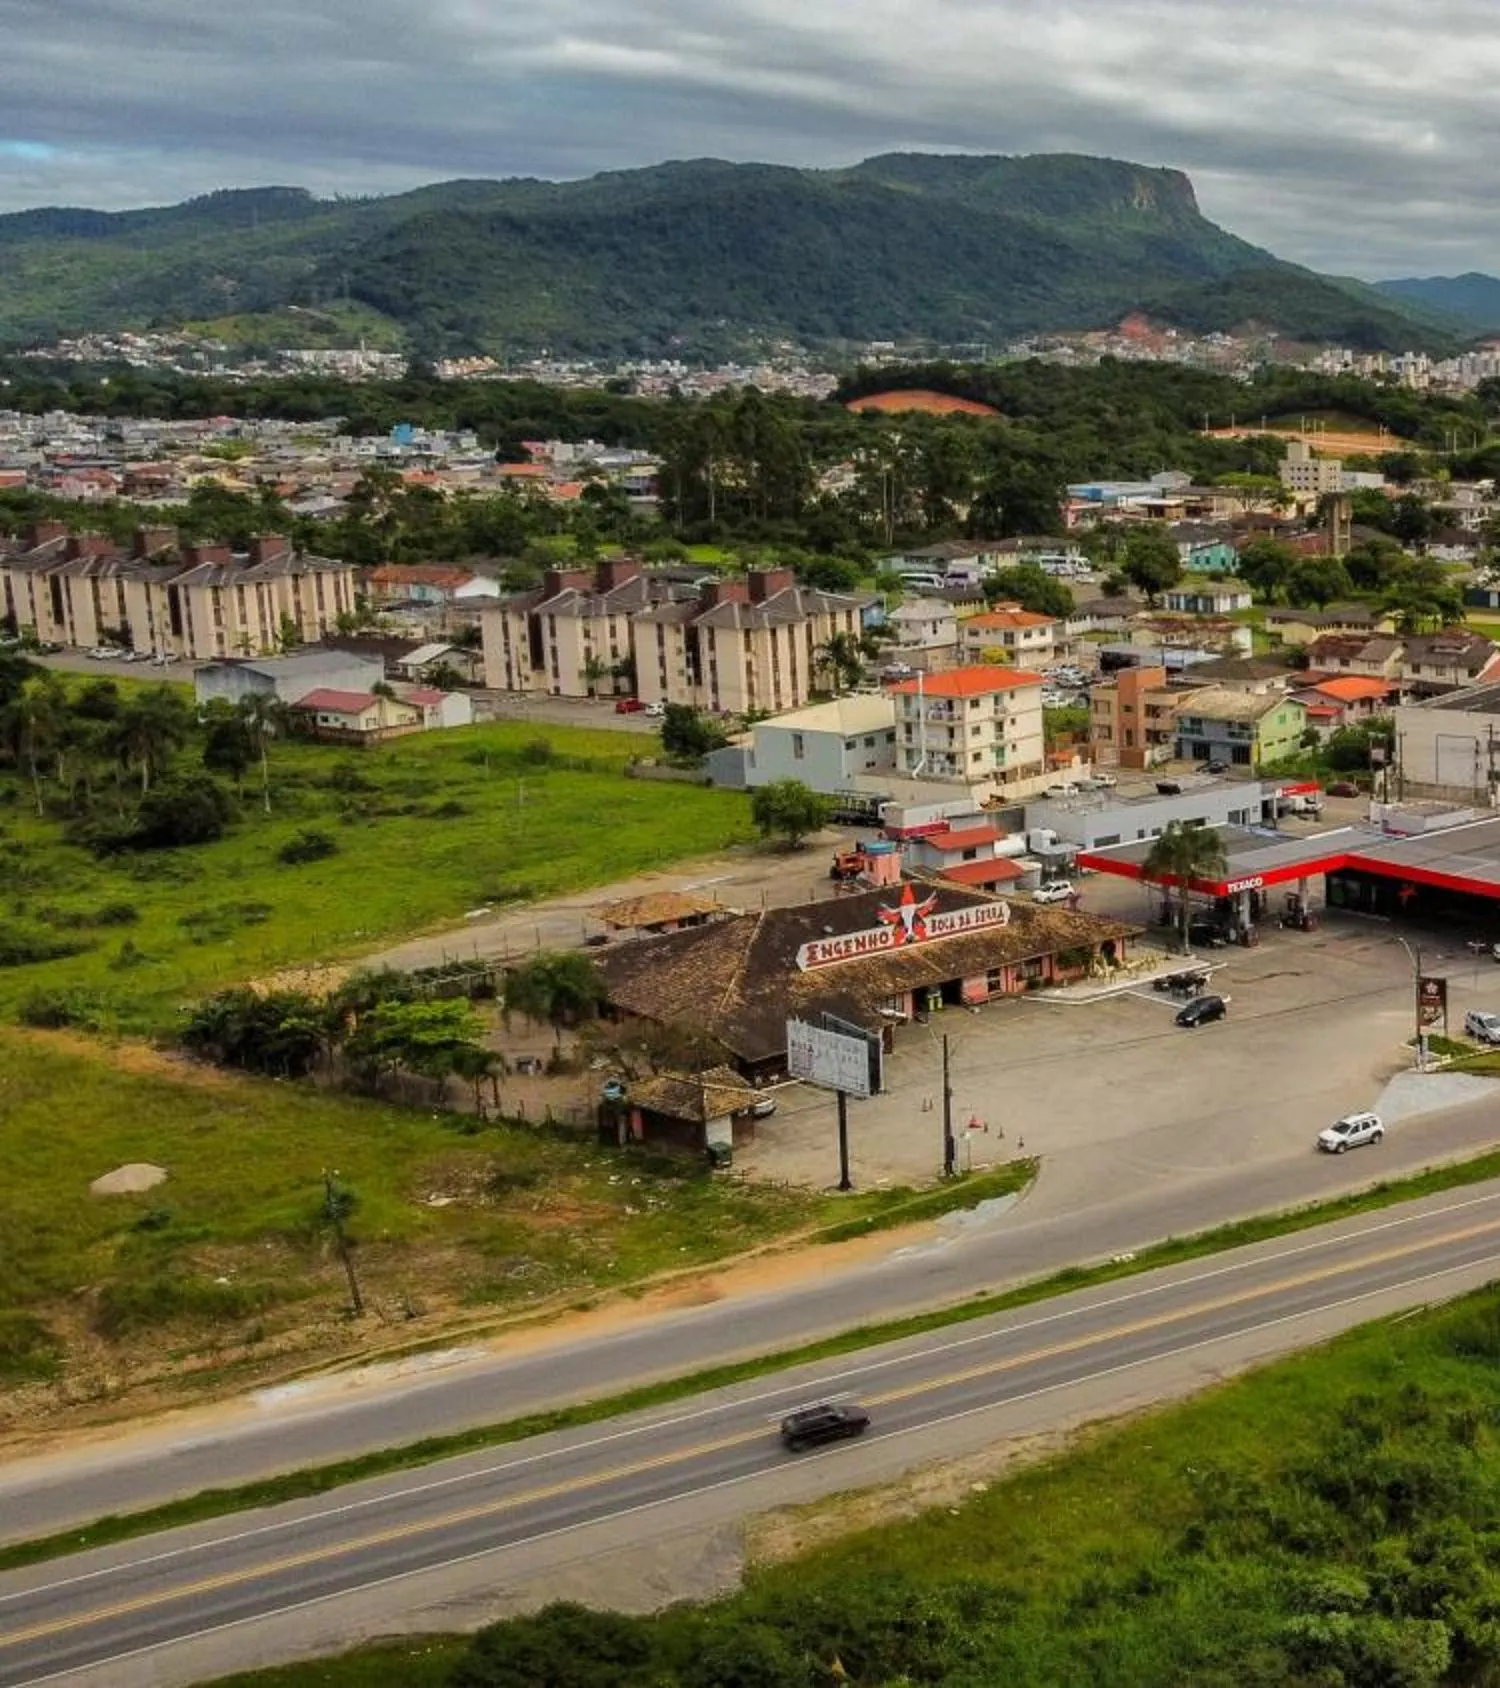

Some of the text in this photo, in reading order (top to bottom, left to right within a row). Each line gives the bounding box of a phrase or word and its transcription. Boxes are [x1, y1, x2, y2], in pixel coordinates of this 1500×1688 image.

[1227, 876, 1263, 893] TEXACO
[931, 915, 956, 933] BOCA
[806, 931, 890, 962] ENGENHO
